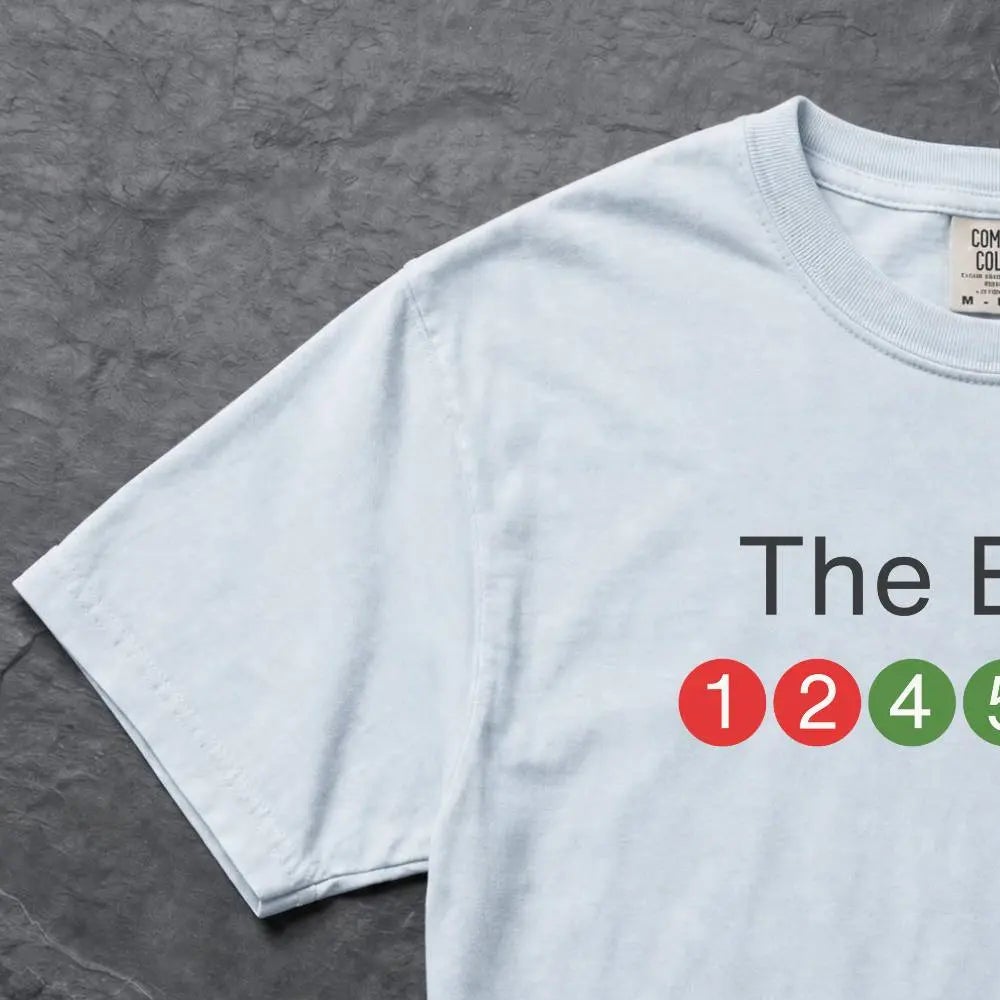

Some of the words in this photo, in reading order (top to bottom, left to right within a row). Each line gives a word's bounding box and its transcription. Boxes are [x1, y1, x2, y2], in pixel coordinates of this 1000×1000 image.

[961, 295, 974, 305] M
[740, 536, 931, 616] The
[707, 674, 729, 728] 1
[800, 674, 836, 729] 2
[890, 674, 931, 728] 4
